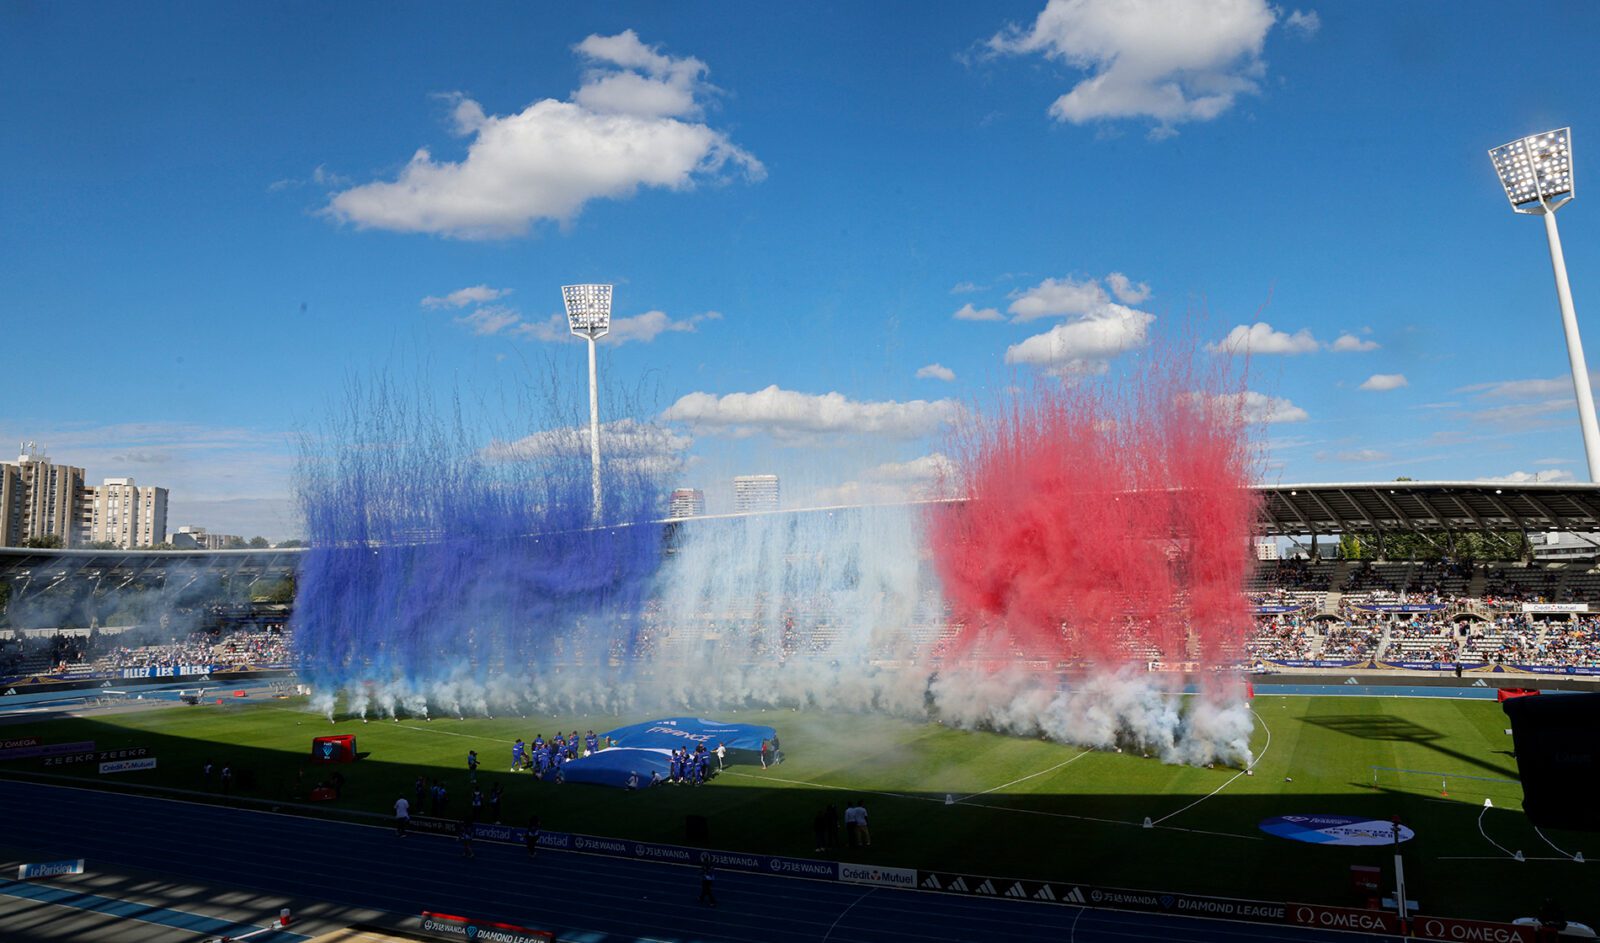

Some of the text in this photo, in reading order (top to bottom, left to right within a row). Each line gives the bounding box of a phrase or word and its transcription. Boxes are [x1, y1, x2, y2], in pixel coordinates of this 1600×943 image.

[123, 667, 151, 678] ALLEZ
[156, 666, 175, 677] LES
[645, 726, 717, 742] FRANCE
[4, 739, 37, 748] OMEGA
[44, 753, 95, 766] ZEEKR
[100, 748, 147, 760] ZEEKR
[102, 761, 154, 772] Crédit Mutuel
[475, 827, 511, 840] randstad
[842, 868, 913, 884] Crédit Mutuel
[1177, 897, 1234, 914] DIAMOND
[1236, 904, 1285, 919] LEAGUE
[1319, 910, 1387, 931] OMEGA
[476, 929, 514, 943] DIAMOND
[1450, 924, 1524, 943] OMEGA
